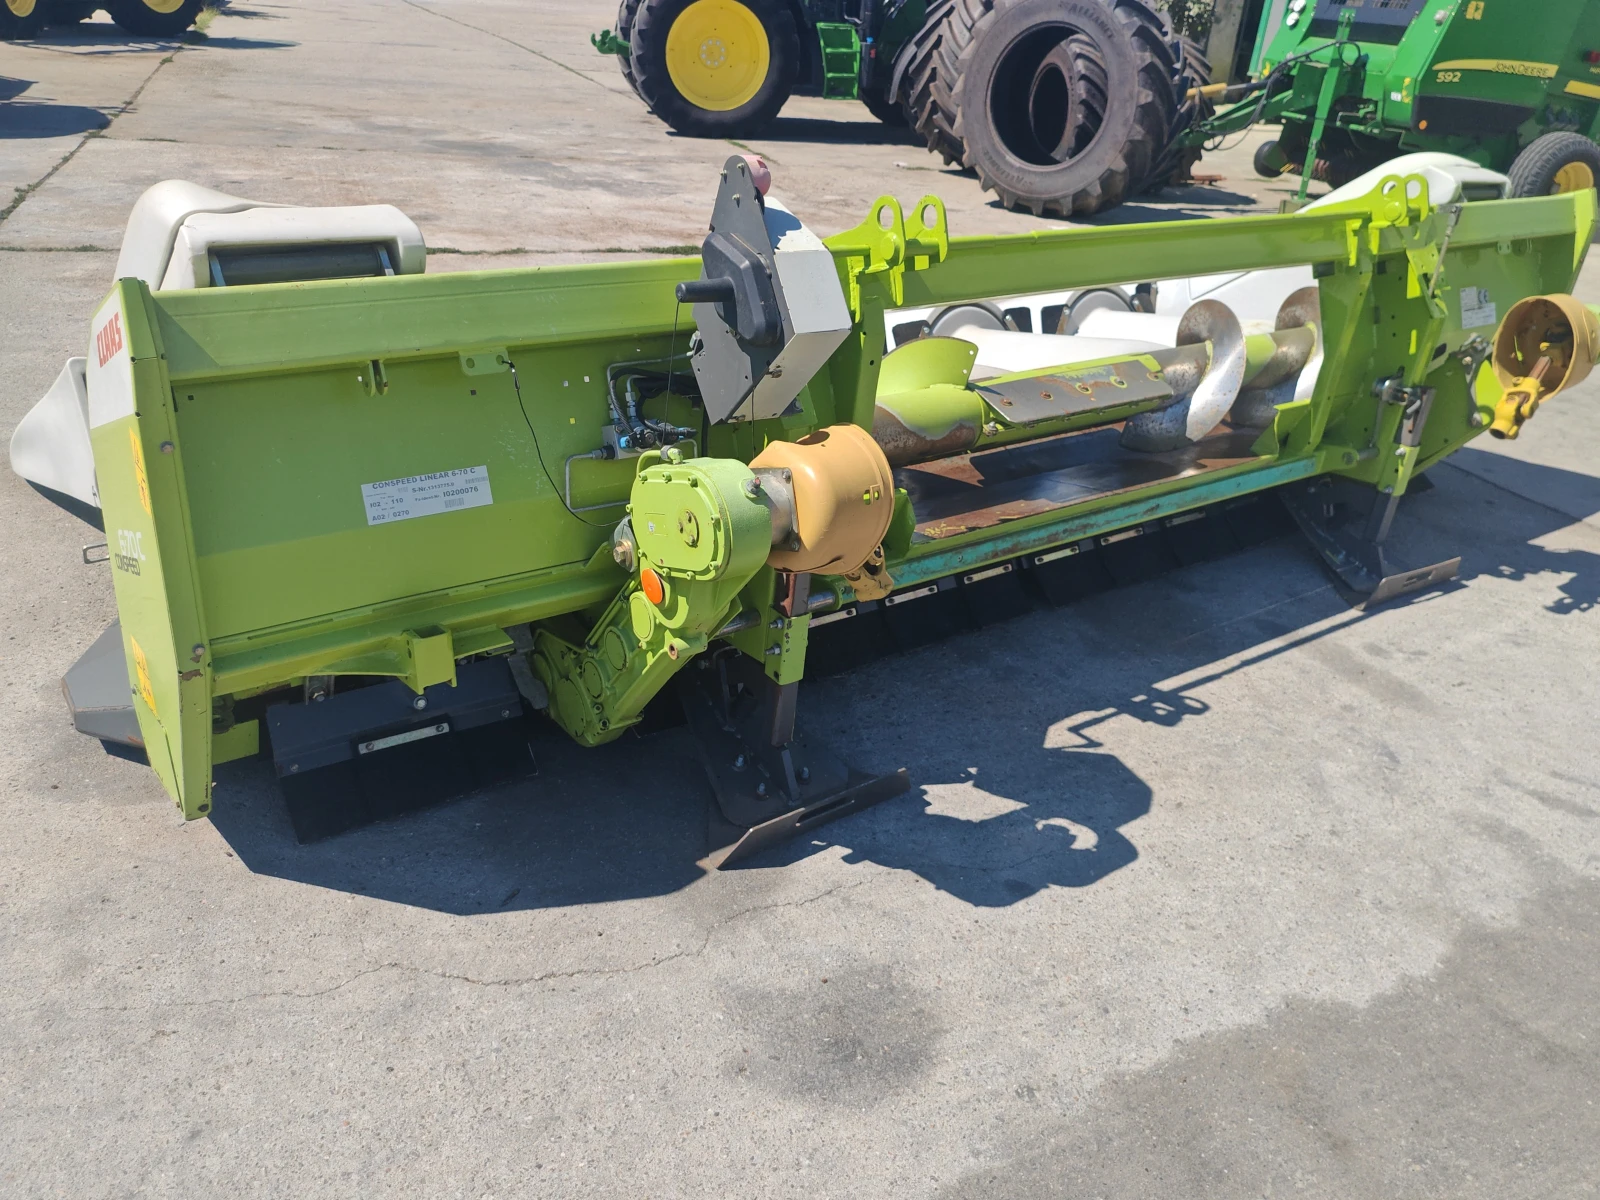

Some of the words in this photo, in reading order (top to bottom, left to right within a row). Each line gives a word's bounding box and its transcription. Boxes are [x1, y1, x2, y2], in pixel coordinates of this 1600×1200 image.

[1436, 71, 1462, 83] 592
[1492, 61, 1518, 75] JOHN
[1517, 63, 1550, 78] DEERE
[96, 311, 123, 369] CLAAS
[372, 477, 418, 490] CONSPEED
[420, 471, 450, 482] LINEAR
[451, 468, 468, 477] 6-70
[392, 510, 410, 518] 0270
[115, 553, 141, 576] CONSPEED
